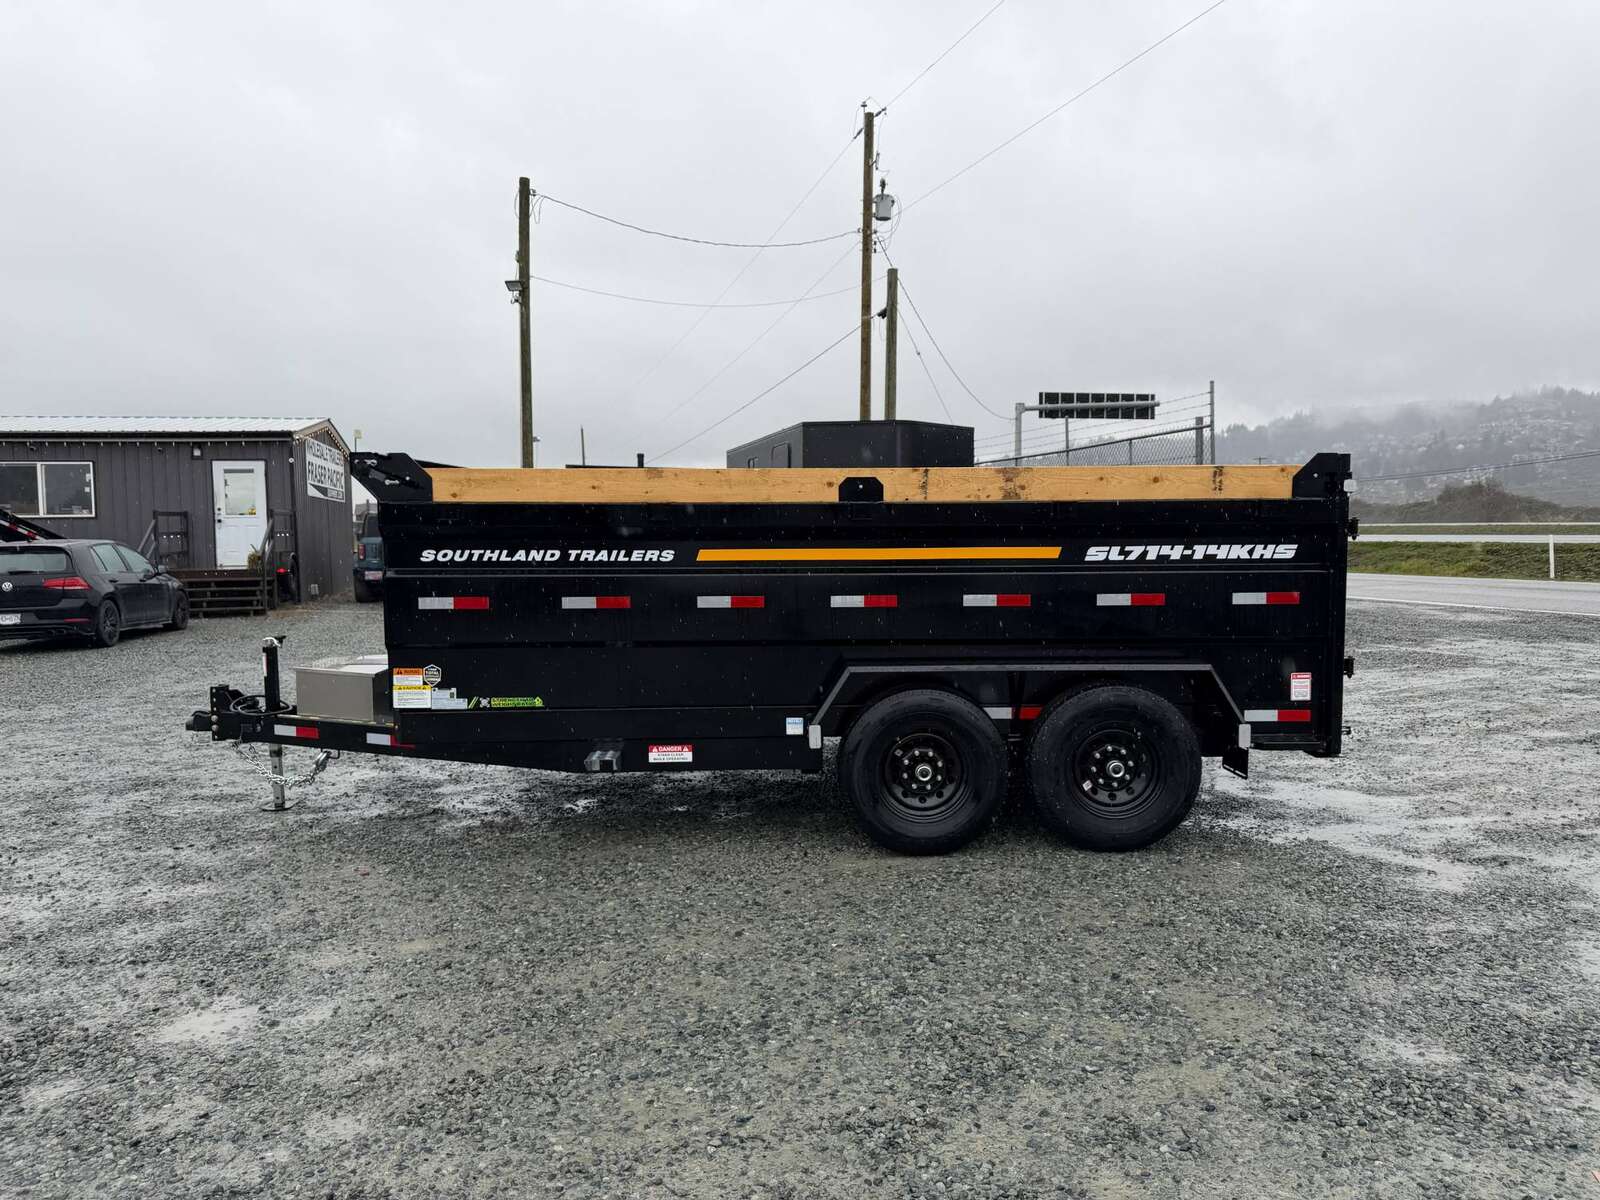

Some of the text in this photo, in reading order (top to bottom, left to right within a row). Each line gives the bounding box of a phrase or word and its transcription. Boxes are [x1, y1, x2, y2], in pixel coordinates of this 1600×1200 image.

[420, 549, 675, 562] SOUTHLAND TRAILERS
[1084, 544, 1299, 561] SL714-14KHS
